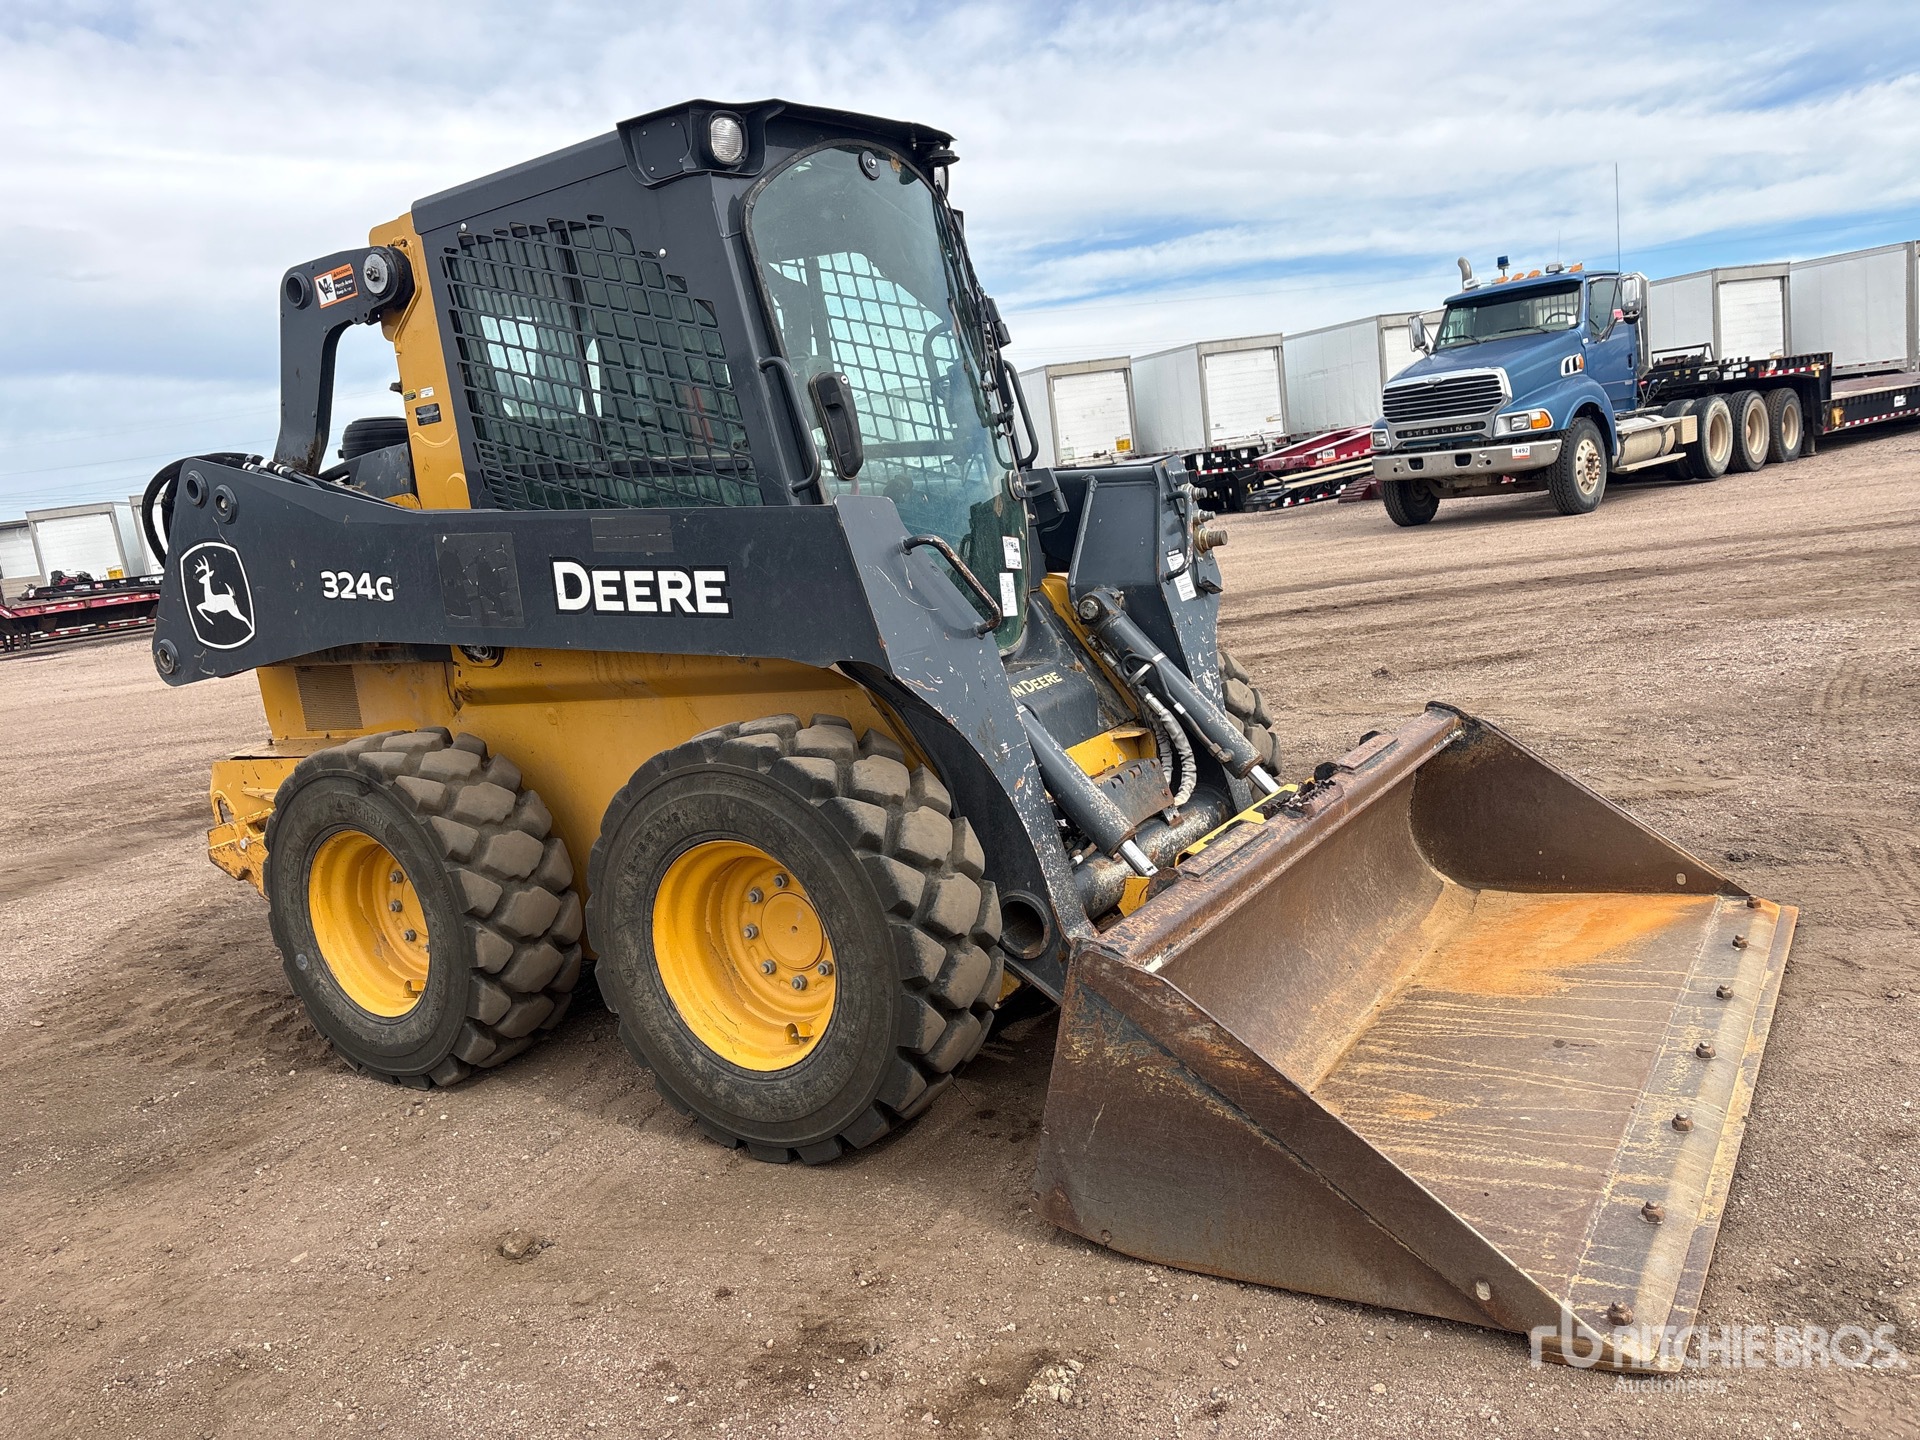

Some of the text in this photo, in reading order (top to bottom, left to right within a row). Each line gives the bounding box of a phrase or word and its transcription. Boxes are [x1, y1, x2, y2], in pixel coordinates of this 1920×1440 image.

[1406, 425, 1473, 437] STERLING
[320, 571, 395, 602] 324G
[552, 561, 730, 614] DEERE
[1020, 671, 1063, 693] DEERE
